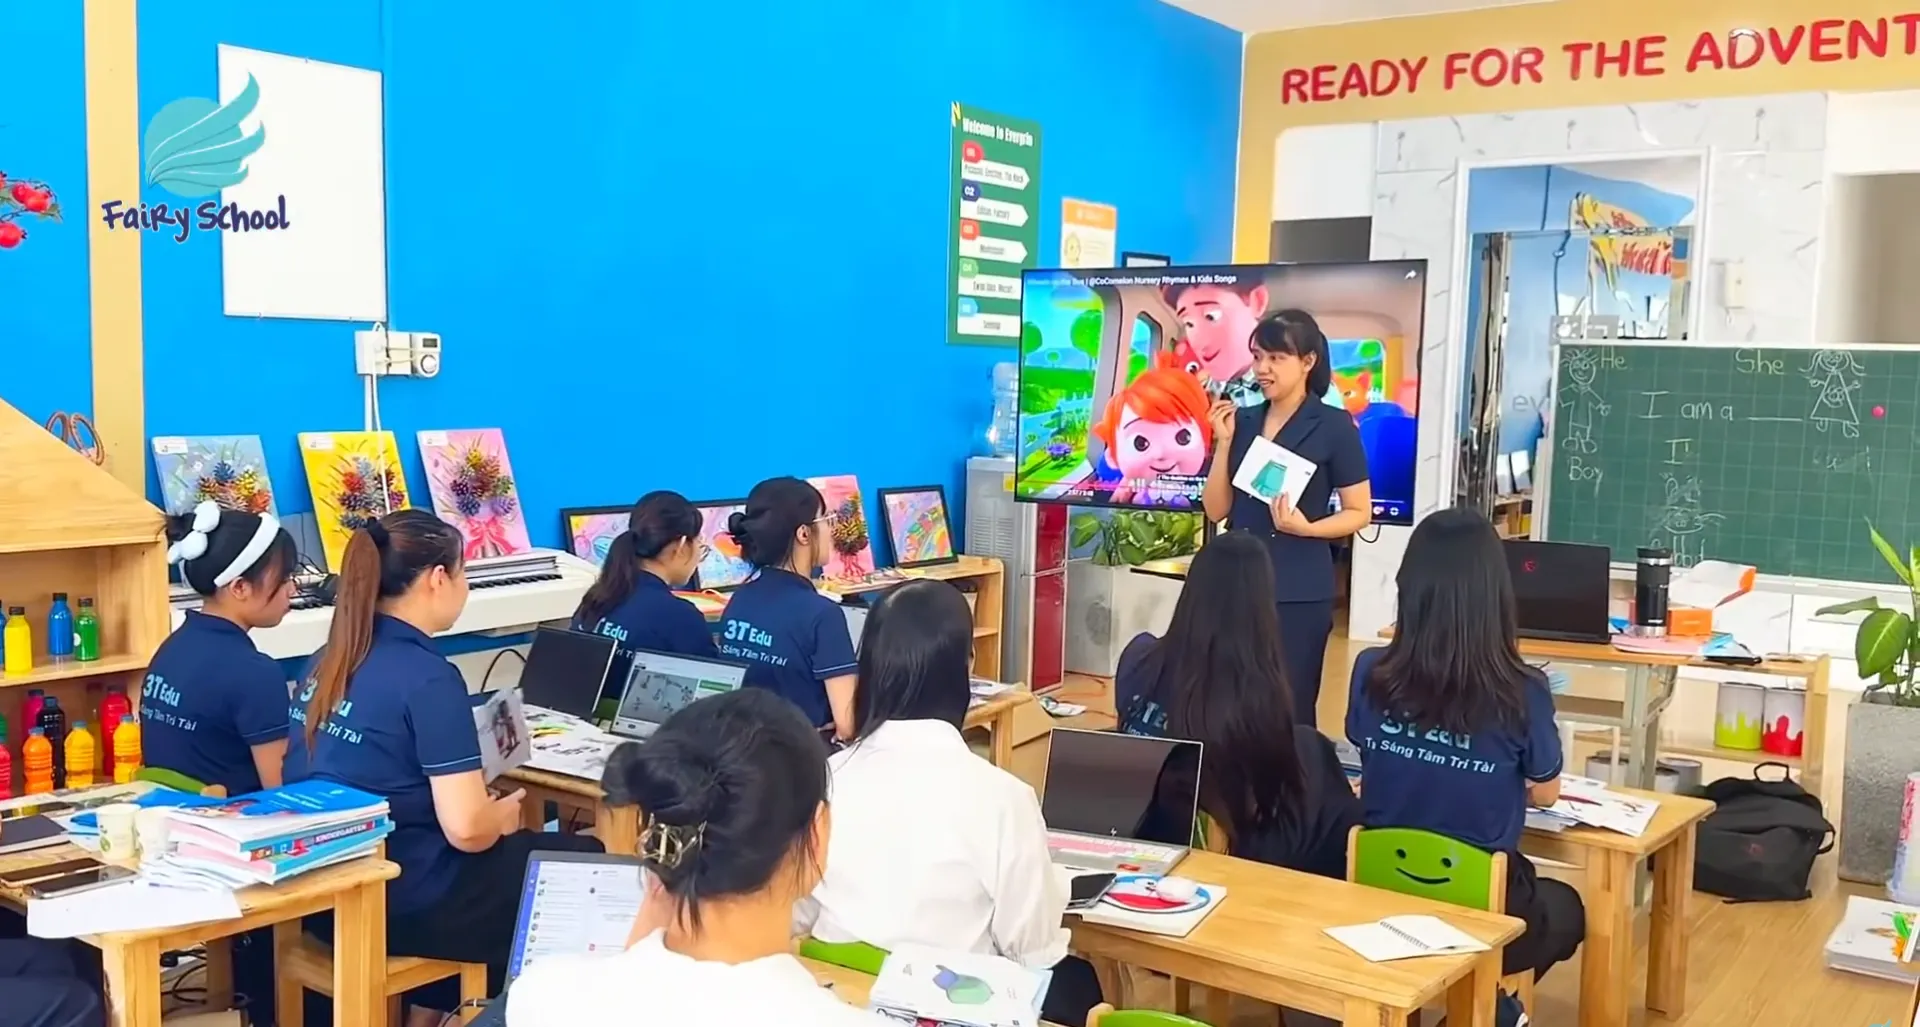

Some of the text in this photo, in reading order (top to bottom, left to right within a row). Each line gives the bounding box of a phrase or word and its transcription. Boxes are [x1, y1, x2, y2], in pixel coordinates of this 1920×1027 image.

[1281, 12, 1920, 105] READY FOR THE ADVENT
[964, 185, 975, 197] 02
[1162, 275, 1189, 286] Rhymes
[1197, 274, 1213, 284] Kids
[1214, 274, 1237, 285] Songs
[1600, 345, 1628, 370] He
[1735, 347, 1785, 375] She
[1638, 390, 1734, 421] I am a
[1569, 457, 1604, 497] Boy
[602, 621, 628, 641] Edu
[723, 619, 772, 647] 3T Edu
[143, 674, 180, 707] 3T Edu
[1380, 740, 1413, 758] Sáng
[1417, 748, 1446, 765] Tâm
[1472, 760, 1496, 774] Tài
[315, 824, 367, 843] KINDERGARTEN
